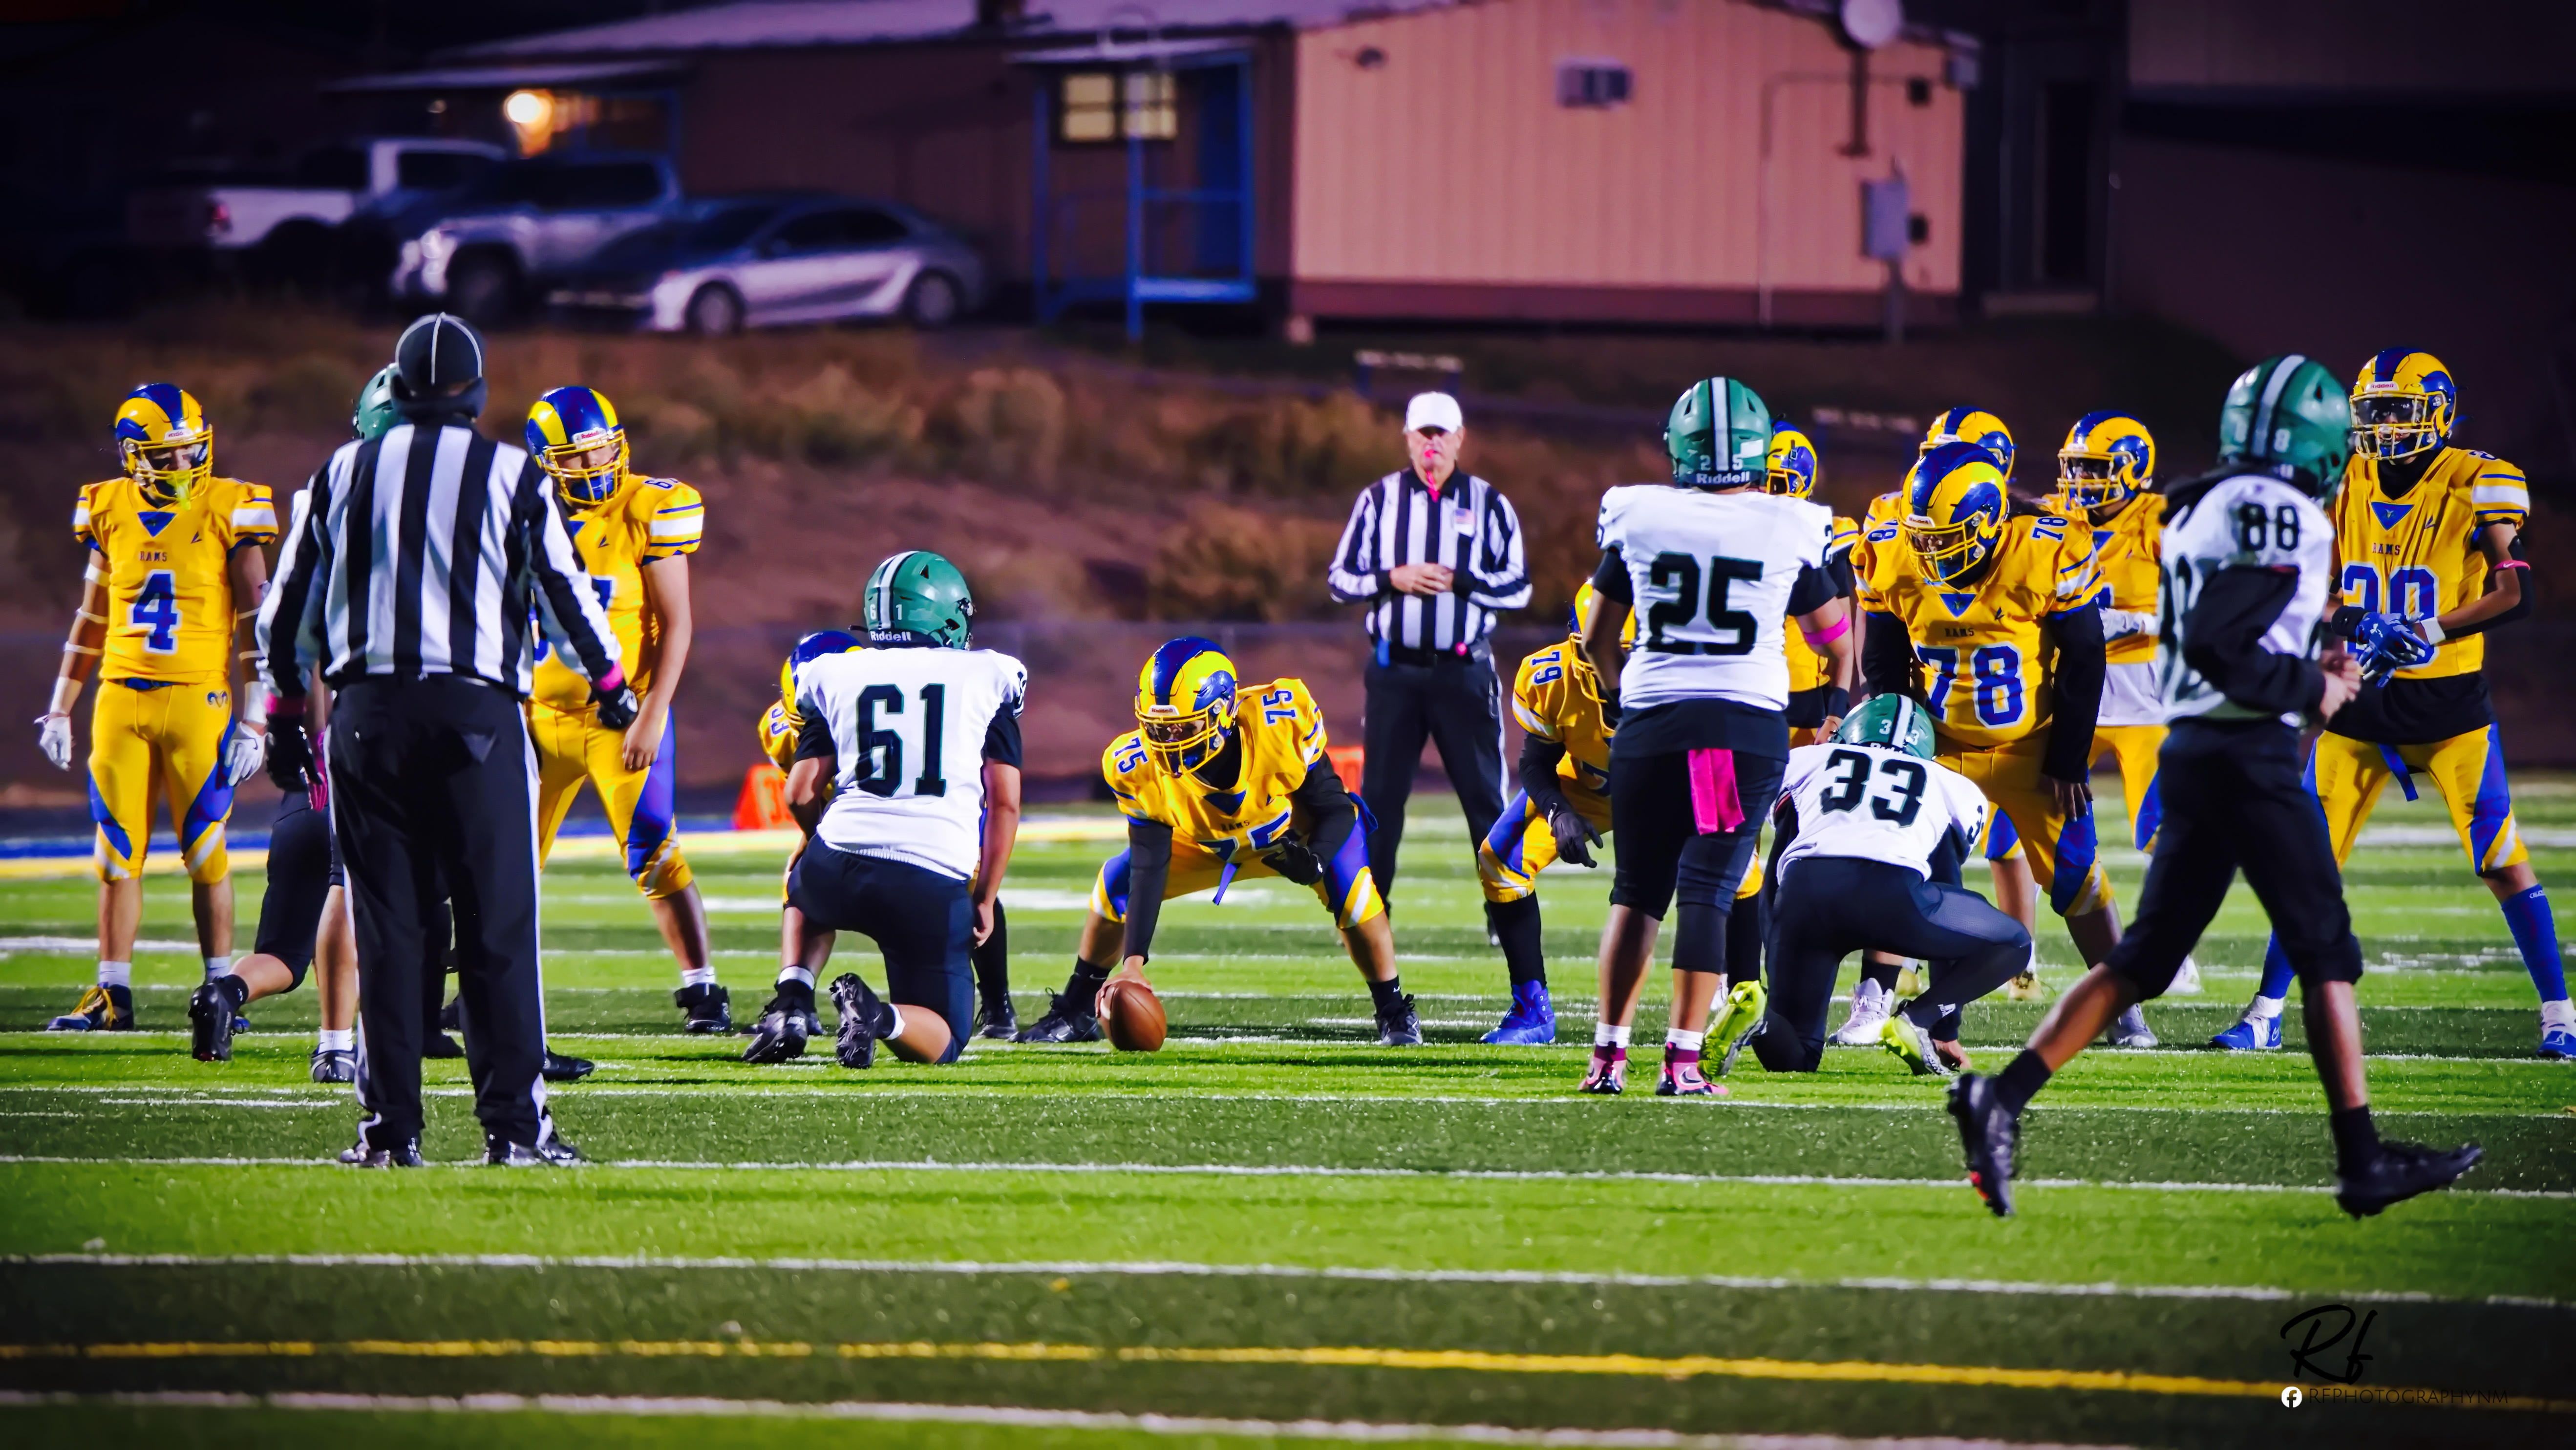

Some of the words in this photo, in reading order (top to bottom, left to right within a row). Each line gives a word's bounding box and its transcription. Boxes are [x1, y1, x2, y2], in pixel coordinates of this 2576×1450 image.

[1696, 470, 1751, 484] Riddell
[2030, 515, 2069, 542] 78
[2239, 501, 2300, 552] 88
[139, 550, 169, 562] RAMS
[2372, 542, 2401, 556] RAMS
[130, 570, 181, 654] 4
[1645, 552, 1765, 656] 25
[869, 630, 912, 641] Riddell
[1945, 627, 1975, 638] RAMS
[1530, 650, 1563, 685] 79
[1914, 641, 2025, 728] 78
[1261, 689, 1298, 726] 75
[856, 683, 947, 798] 61
[1114, 736, 1149, 774] 75
[1819, 748, 1928, 829] 33
[1221, 819, 1251, 832] RAMS
